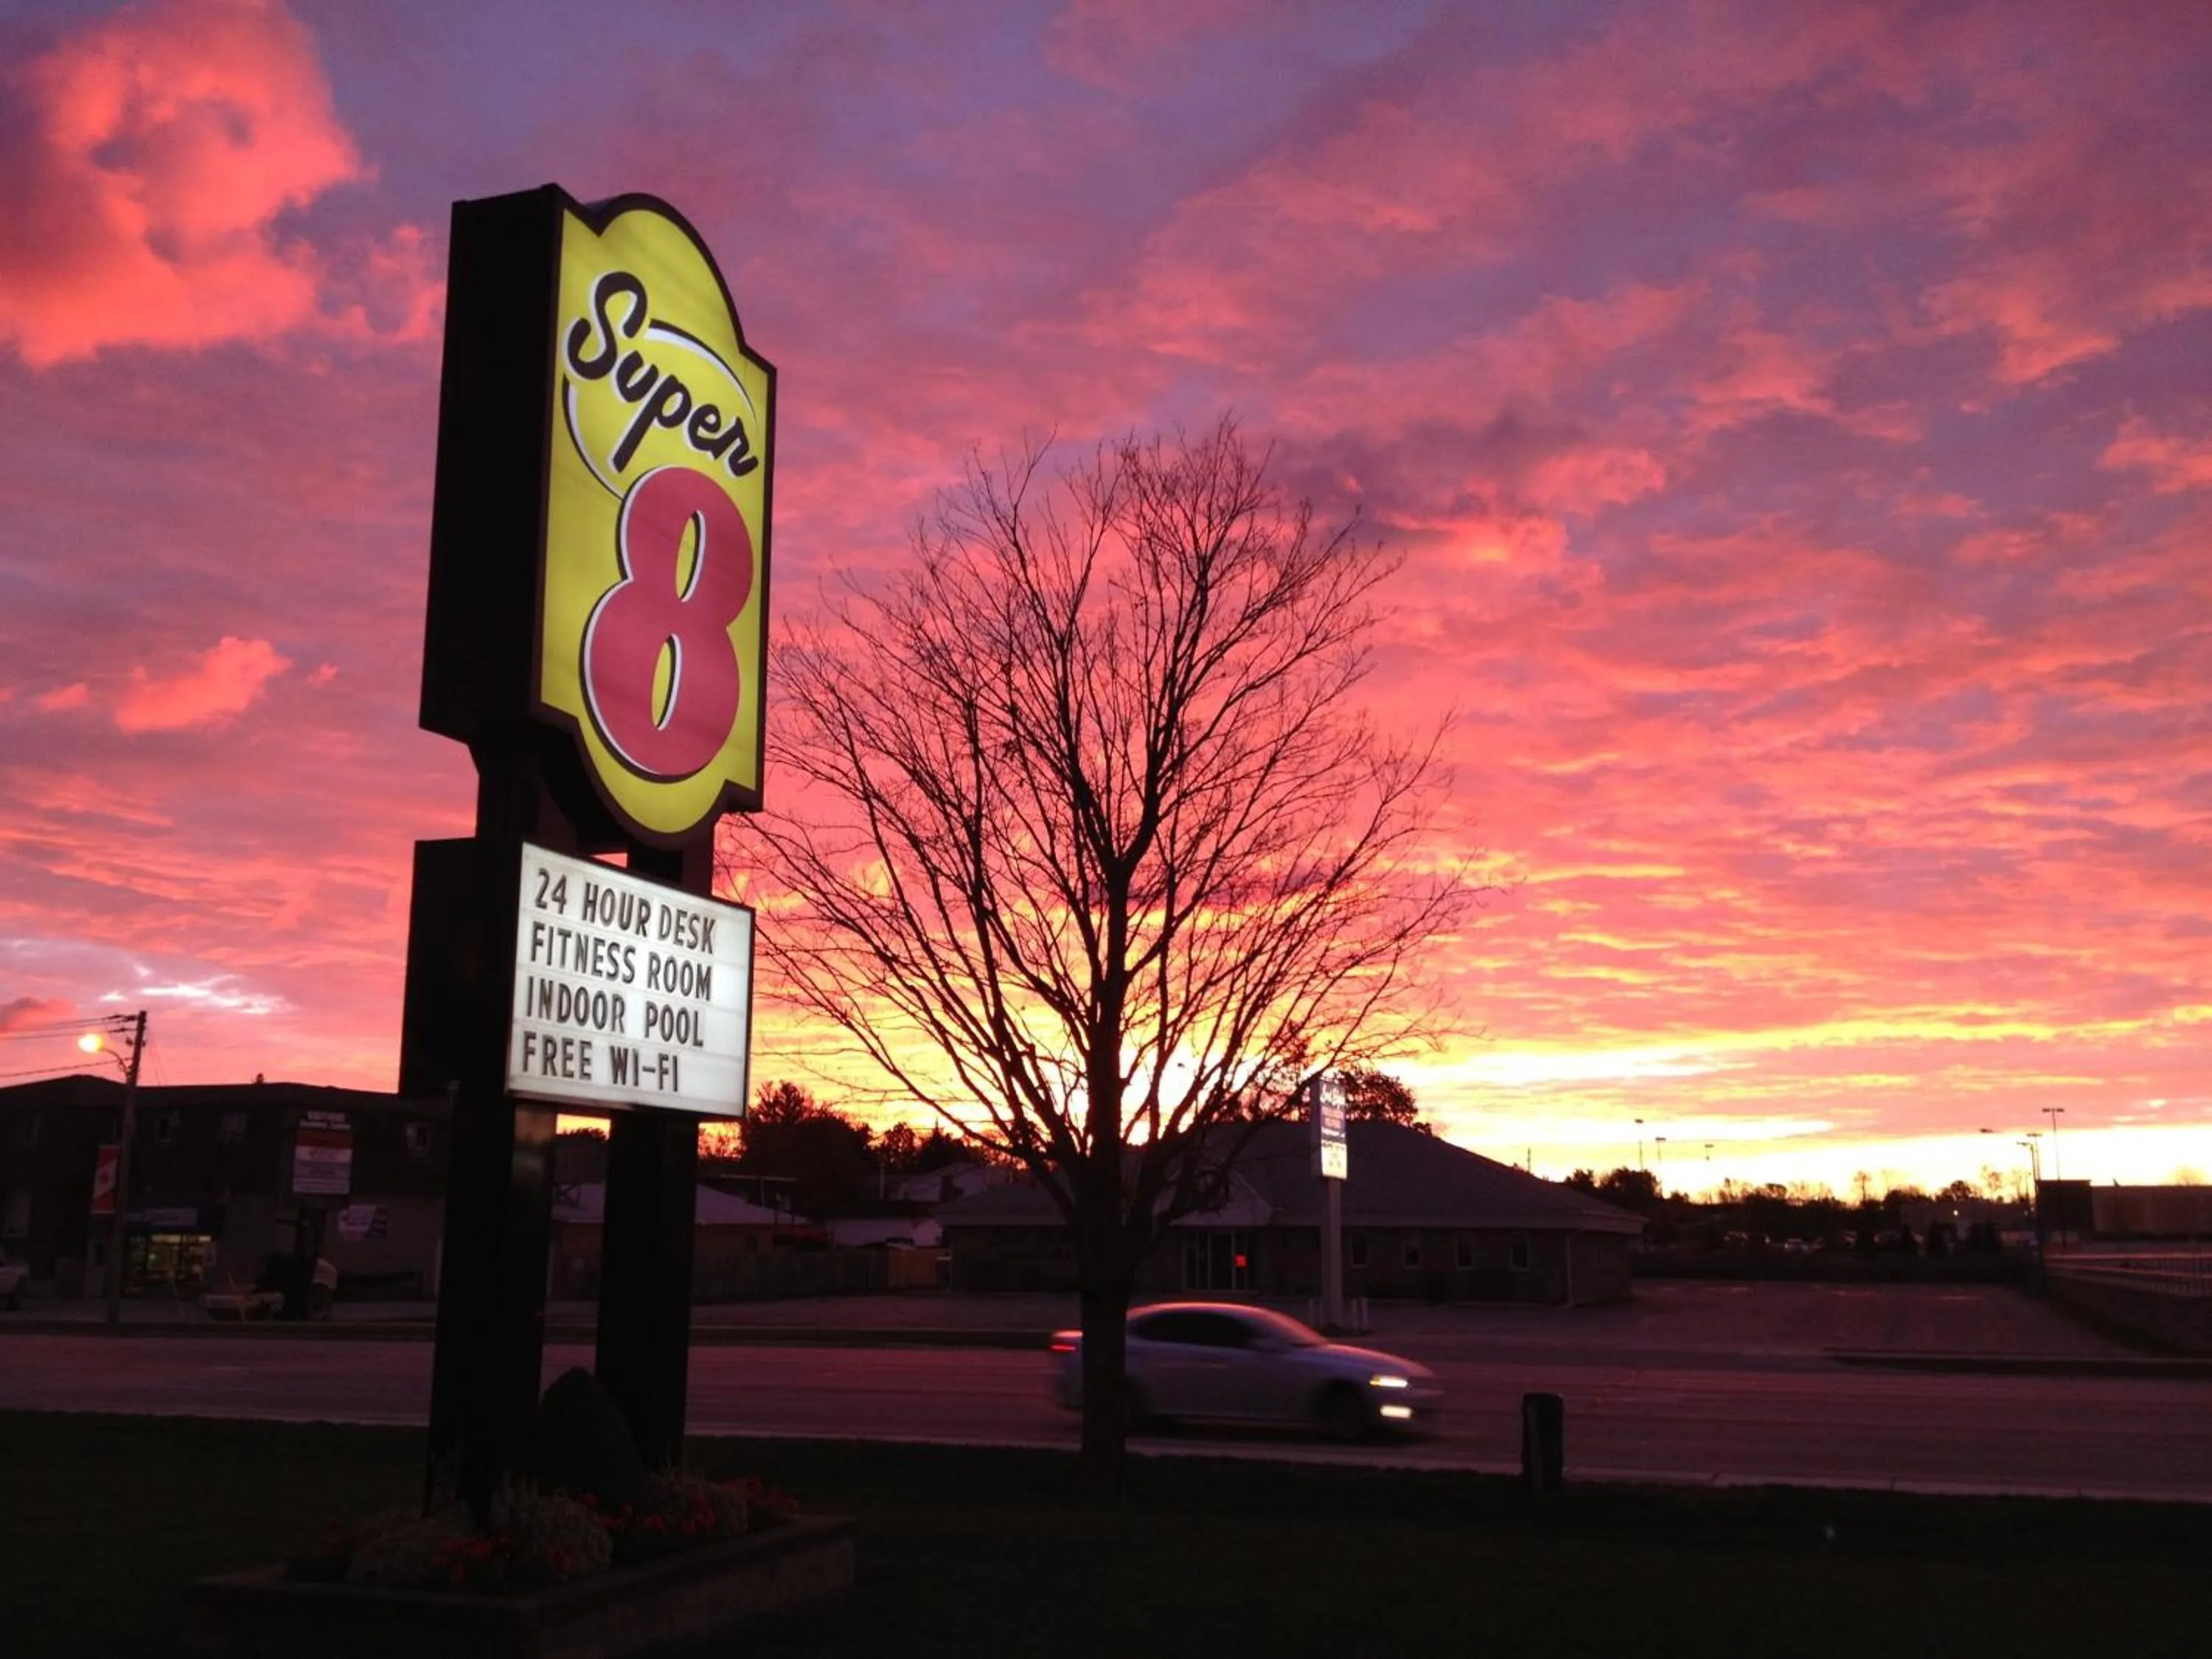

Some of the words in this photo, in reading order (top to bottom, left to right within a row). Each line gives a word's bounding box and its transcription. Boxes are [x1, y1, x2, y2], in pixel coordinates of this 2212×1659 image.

[565, 271, 759, 477] Super
[580, 465, 754, 783] 8
[535, 867, 567, 914] 24
[582, 882, 651, 937] HOUR
[658, 905, 716, 954] DESK
[531, 921, 636, 984] FITNESS
[647, 952, 712, 1001] ROOM
[526, 976, 625, 1034] INDOOR
[644, 1001, 703, 1048] POOL
[522, 1031, 592, 1080] FREE
[610, 1046, 678, 1092] WI-FI
